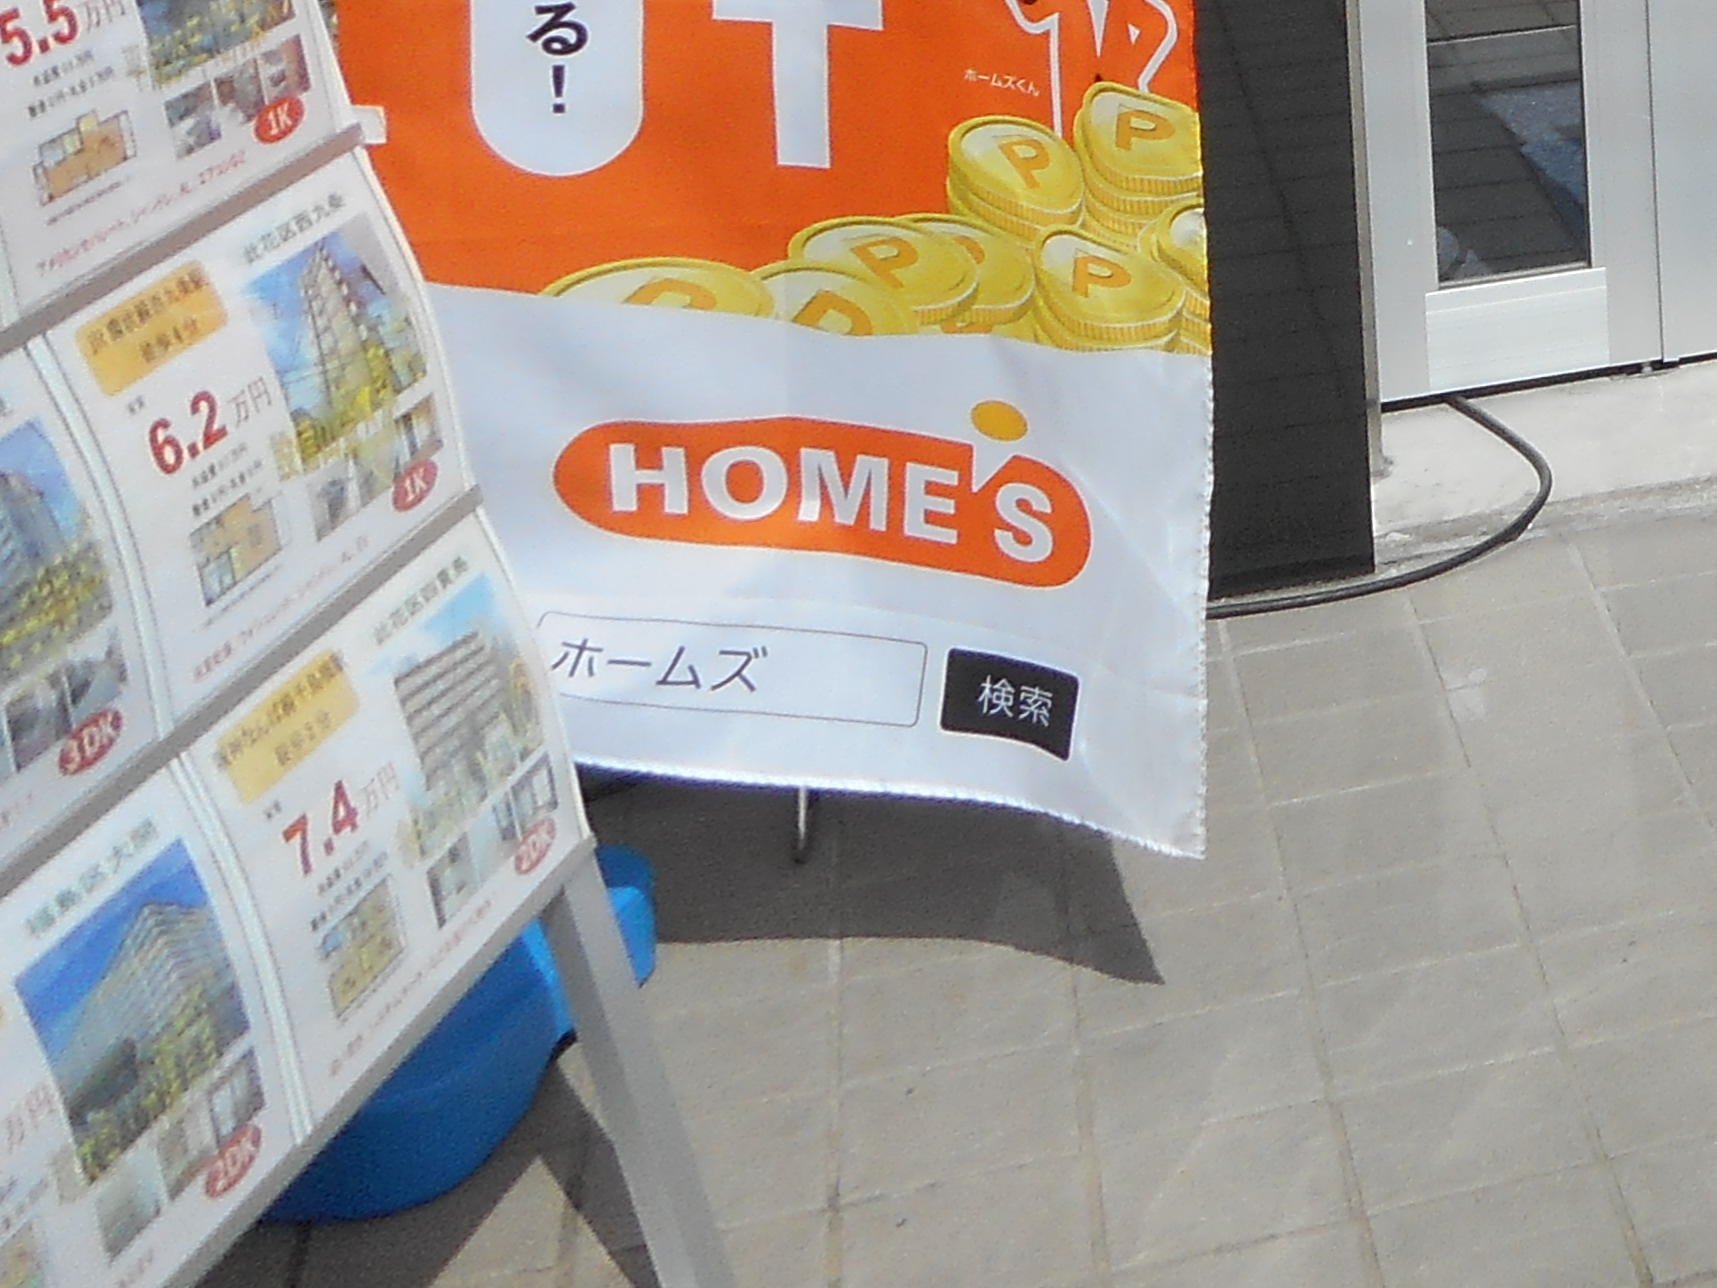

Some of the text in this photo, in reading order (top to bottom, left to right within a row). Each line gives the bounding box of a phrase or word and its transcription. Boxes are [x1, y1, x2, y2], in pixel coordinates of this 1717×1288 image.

[963, 68, 1041, 99] ホームズくん
[266, 102, 294, 137] 1K
[403, 470, 429, 503] 1K
[608, 436, 1056, 566] HOME'S
[551, 637, 1053, 727] ホームズ 検索
